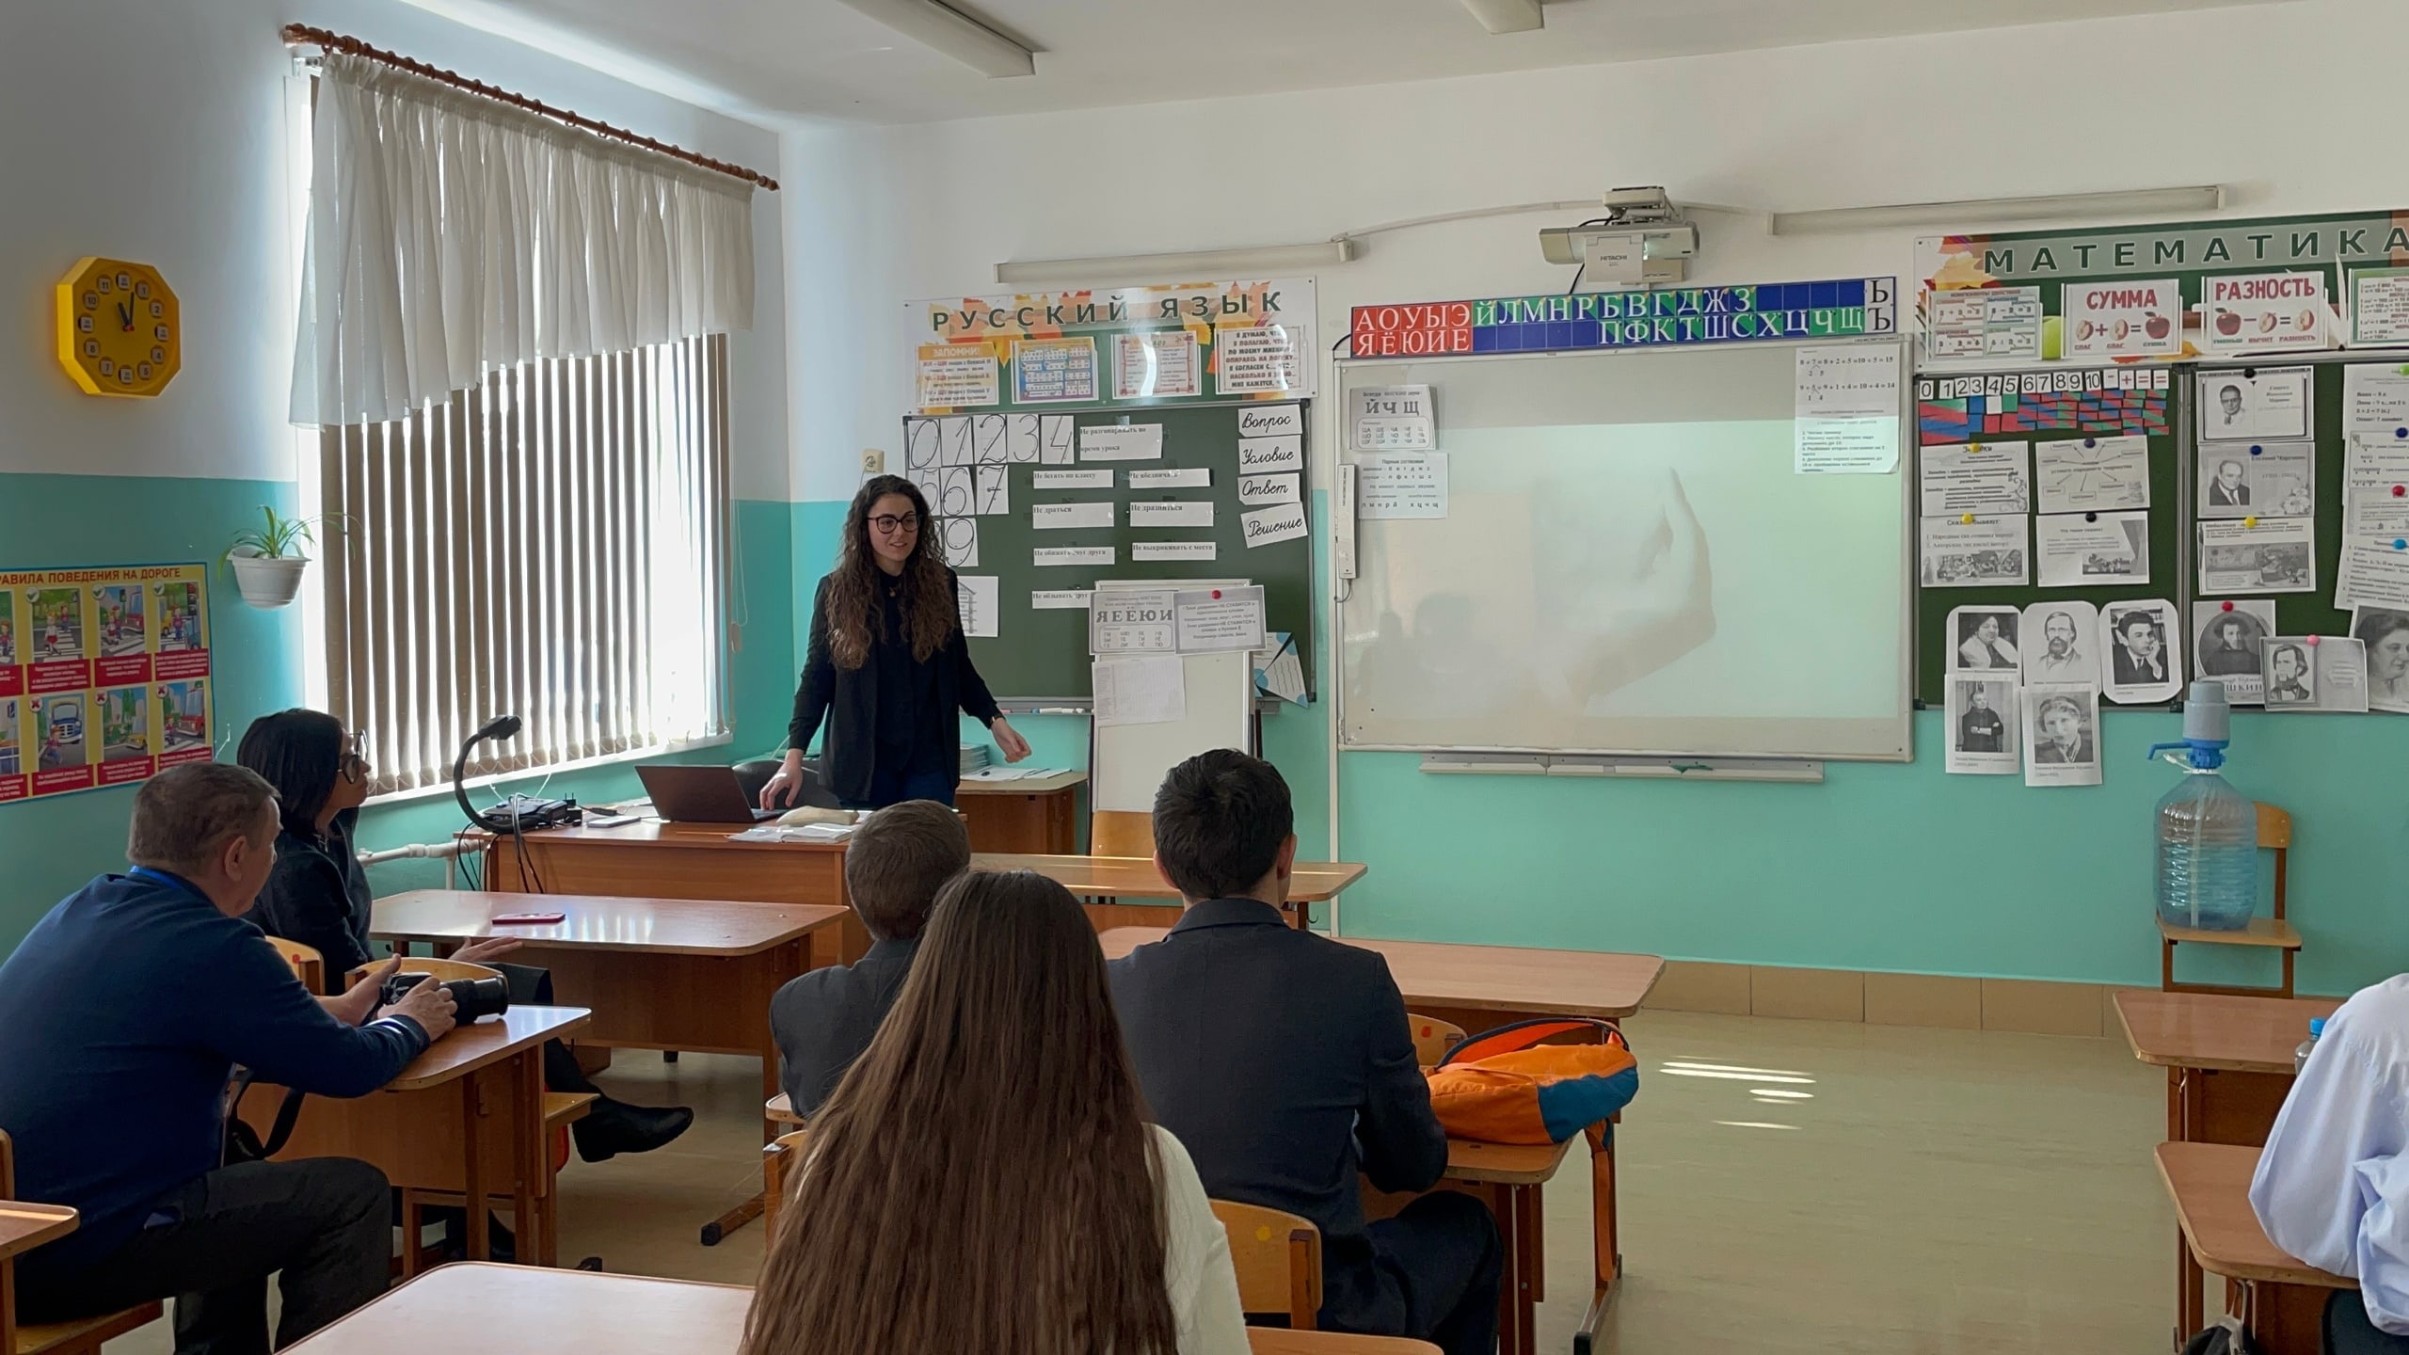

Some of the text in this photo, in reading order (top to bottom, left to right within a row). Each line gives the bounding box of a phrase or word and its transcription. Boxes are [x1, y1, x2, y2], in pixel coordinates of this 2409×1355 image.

[1984, 227, 2409, 275] МАТЕМАТИКА
[2086, 289, 2158, 310] СУММА
[2215, 278, 2315, 300] РАЗНОСТЬ
[933, 291, 1281, 331] РУССКИЙ ЯЗЫК
[1921, 382, 1931, 397] 0
[1943, 383, 1951, 397] 1
[1957, 380, 1968, 395] 2
[1972, 378, 1982, 393] 3
[1988, 378, 1999, 394] 4
[2005, 378, 2016, 393] 5
[2024, 376, 2034, 391] 6
[2039, 375, 2049, 390] 7
[2056, 374, 2066, 389] 8
[2070, 374, 2080, 389] 9
[2086, 373, 2100, 389] 10
[1365, 398, 1420, 417] Й Ч Щ
[1242, 412, 1291, 433] Вопрос
[911, 414, 1072, 468] 0 1 2 3 4
[1242, 446, 1294, 465] Условие
[943, 467, 968, 516] 6
[979, 465, 1006, 514] 7
[1242, 479, 1288, 497] Ответ
[1045, 506, 1072, 514] драться
[1248, 517, 1302, 538] Решение
[945, 518, 975, 567] 9
[0, 567, 181, 585] АВИЛА ПОВЕДЕНИЯ НА ДОРОГЕ
[1096, 610, 1108, 623] Я
[1112, 610, 1123, 622] Е
[1139, 609, 1156, 622] Ю
[1160, 609, 1173, 621] И
[2225, 683, 2263, 692] ШКИН
